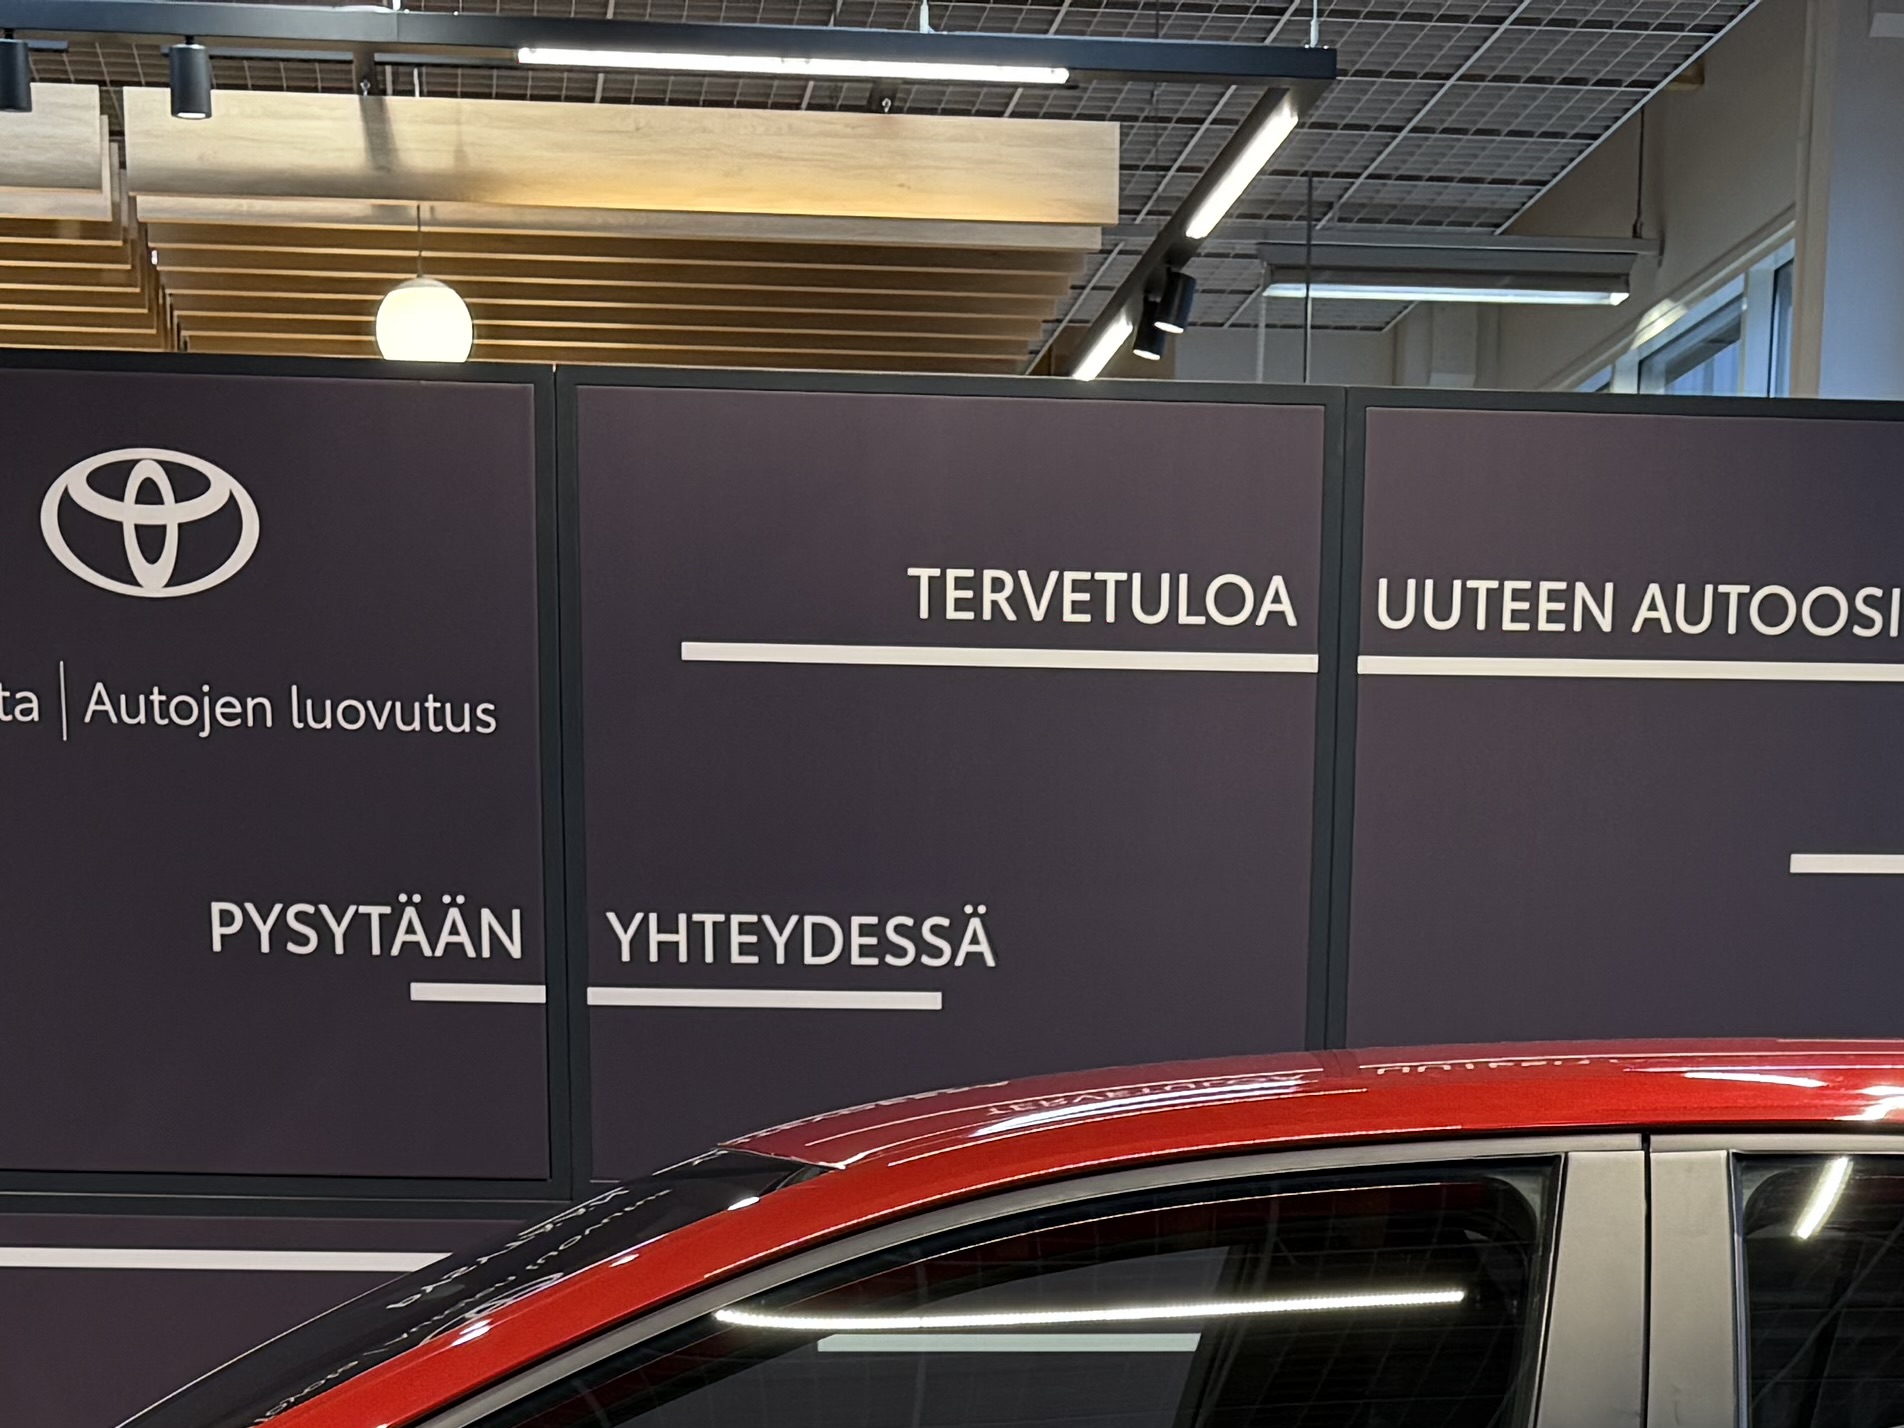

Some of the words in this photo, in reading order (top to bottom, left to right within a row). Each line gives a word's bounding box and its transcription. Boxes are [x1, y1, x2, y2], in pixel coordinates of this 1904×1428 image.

[907, 567, 1298, 627] TERVETULOA
[1377, 577, 1614, 633] UUTEEN
[1631, 582, 1901, 638] AUTOOSI
[84, 681, 273, 738] Autojen
[291, 684, 497, 734] luovutus
[210, 892, 522, 959] PYSYTÄÄN
[605, 904, 996, 968] YHTEYDESSÄ
